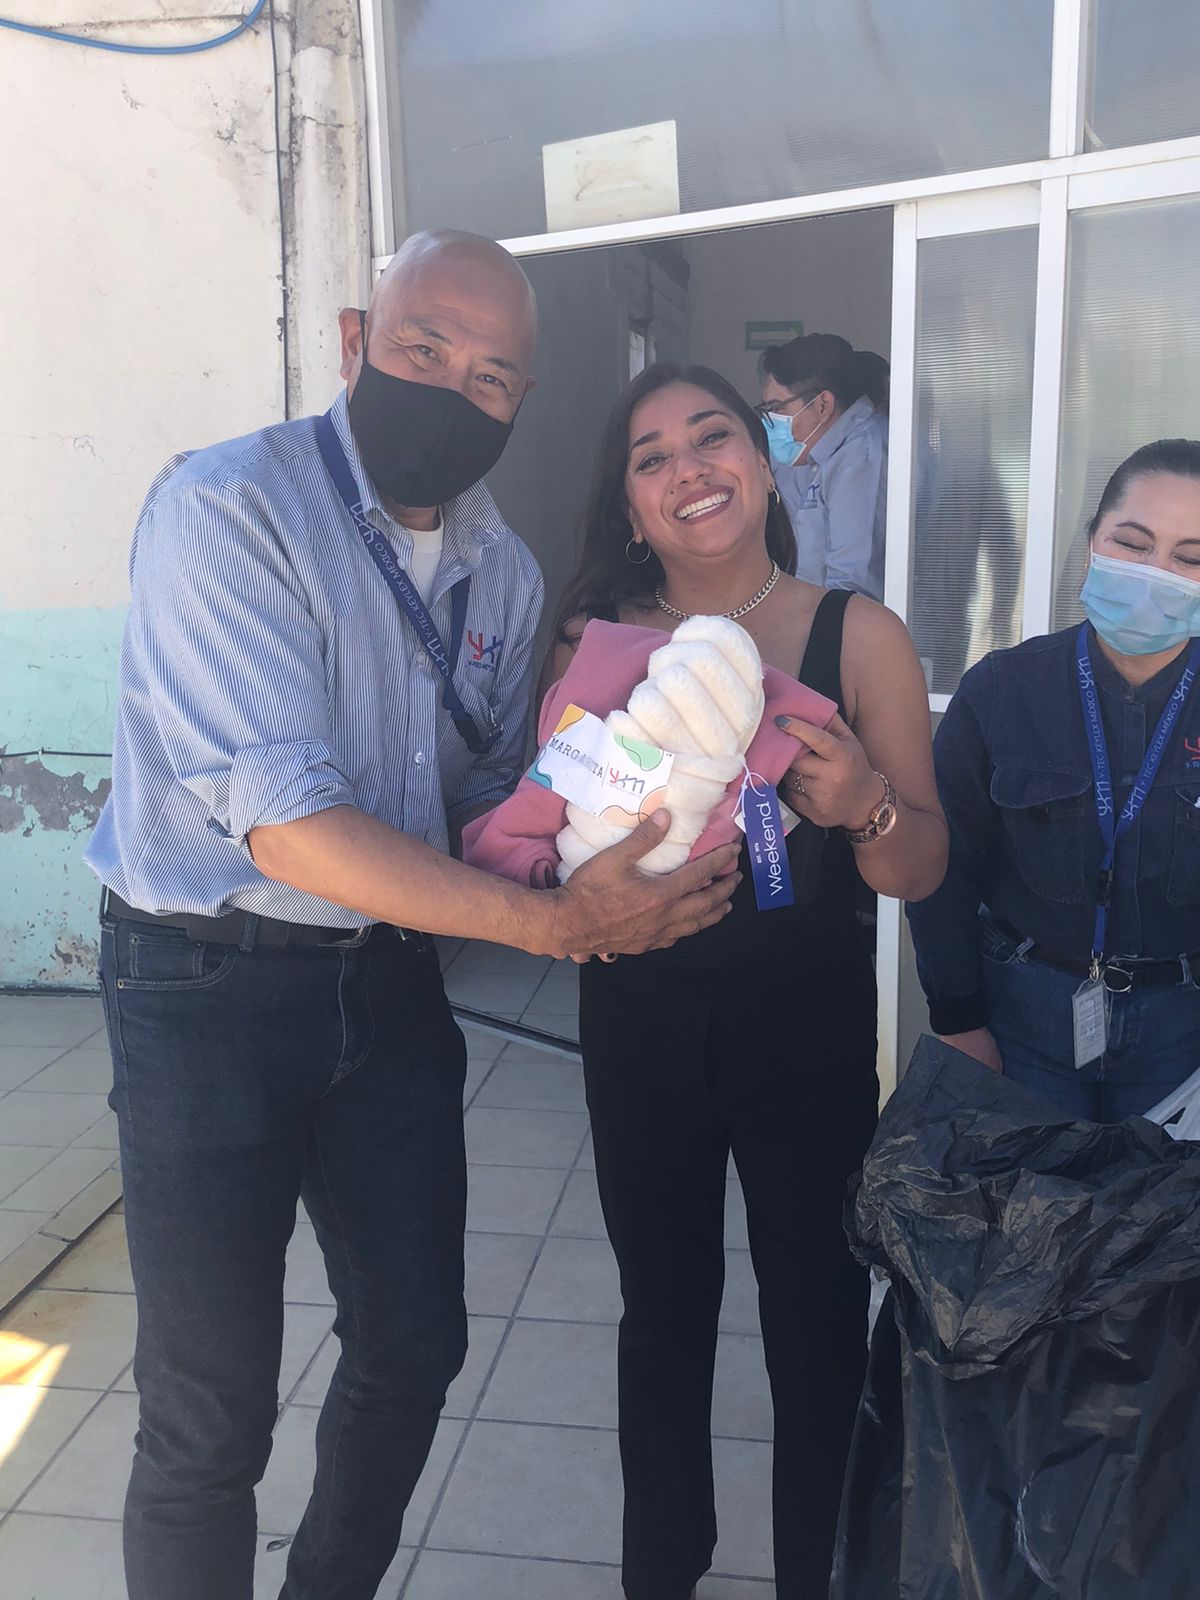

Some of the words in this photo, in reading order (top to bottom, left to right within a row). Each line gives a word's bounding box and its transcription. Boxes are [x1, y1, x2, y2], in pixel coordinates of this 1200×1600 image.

[397, 579, 420, 612] KEYLEX
[415, 611, 431, 638] Y-TEC
[548, 737, 604, 779] MARGATA
[756, 801, 783, 896] Weekend
